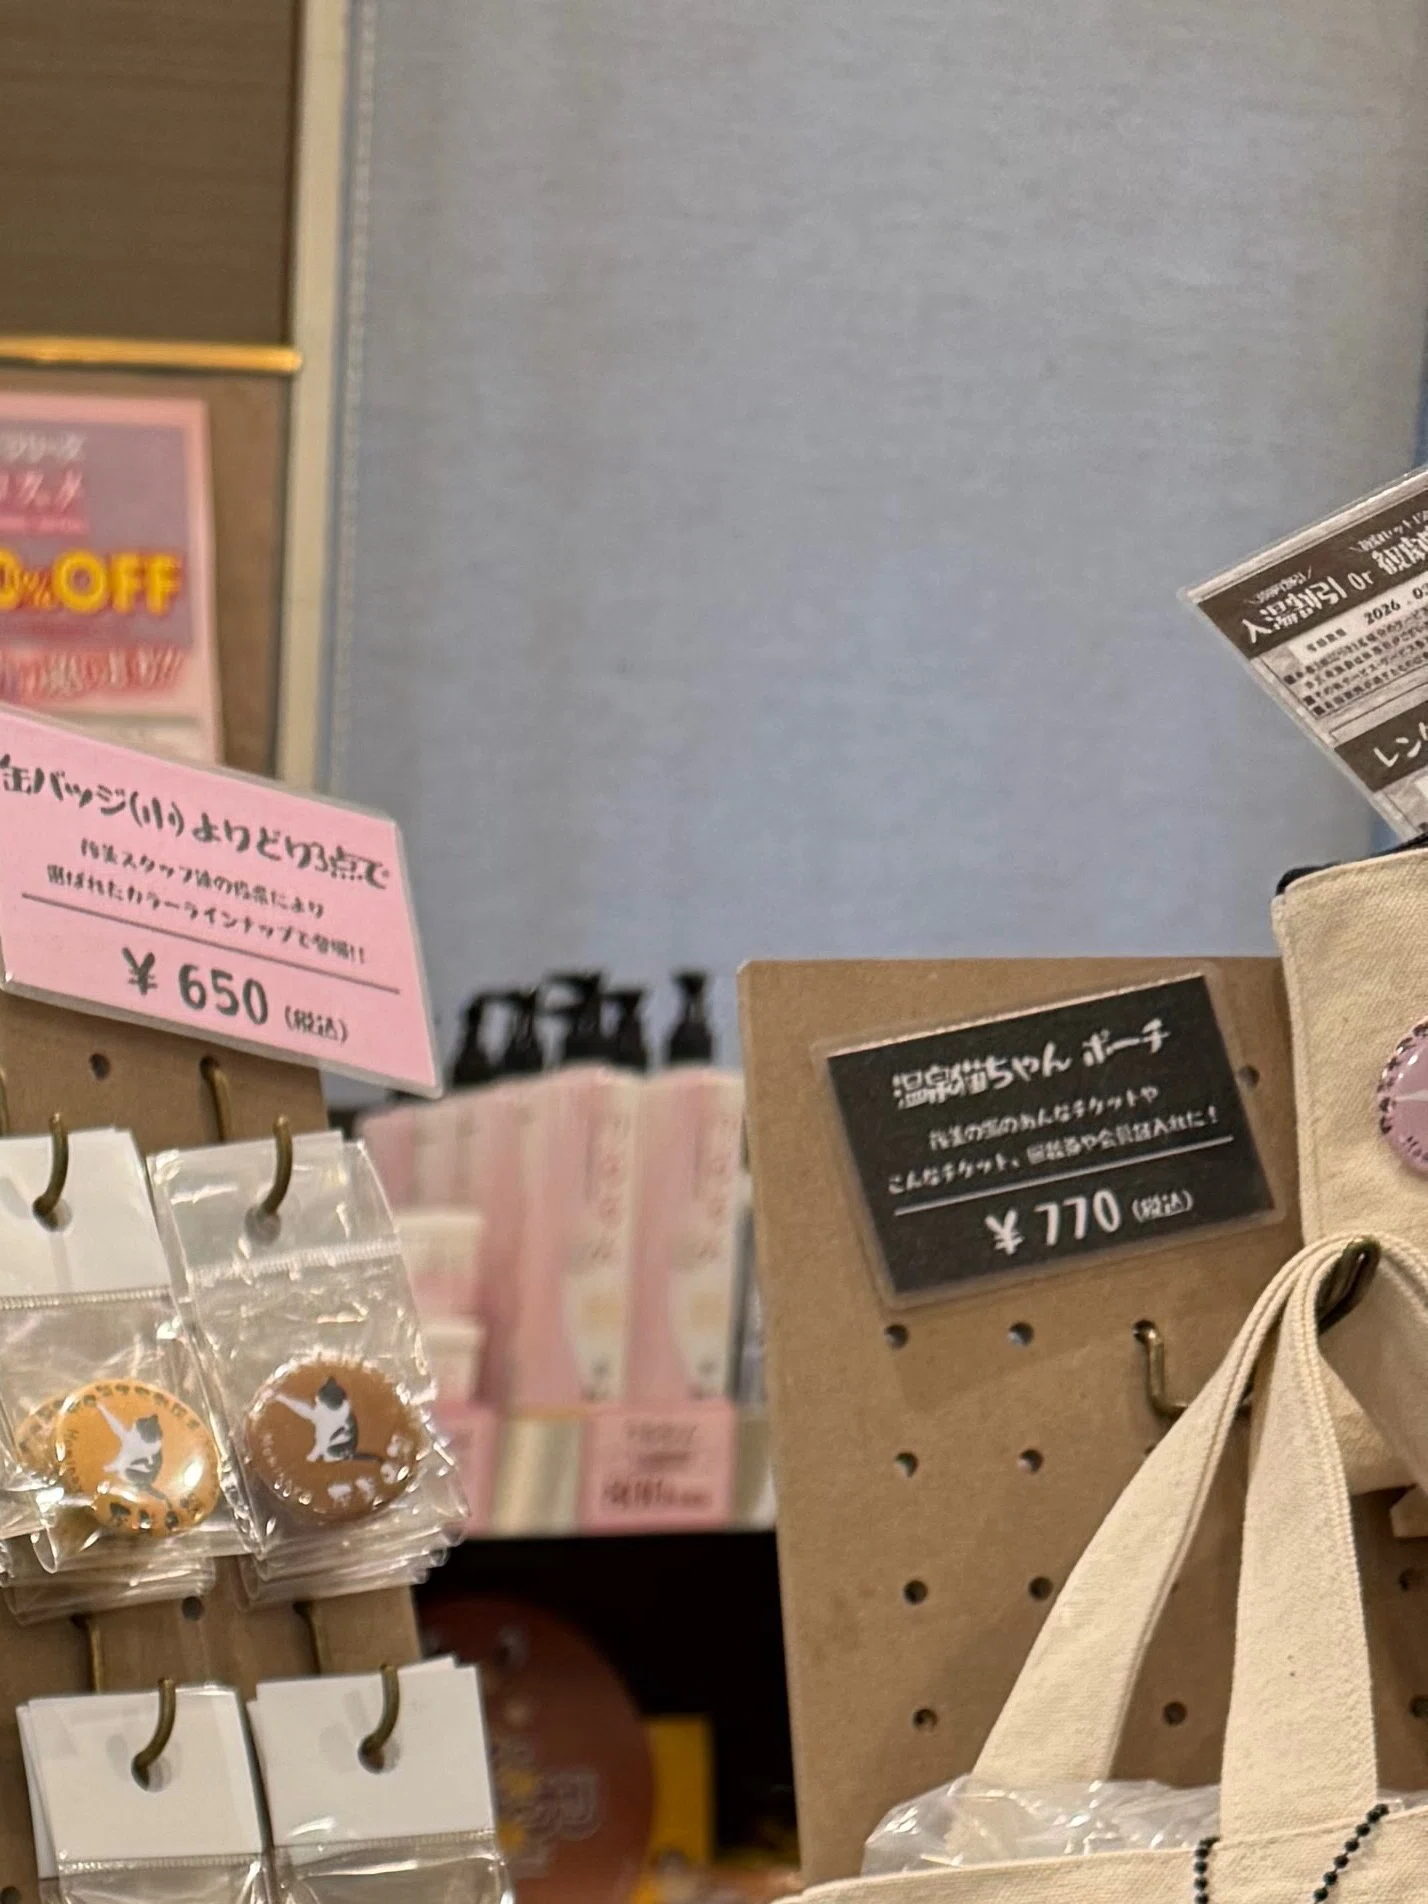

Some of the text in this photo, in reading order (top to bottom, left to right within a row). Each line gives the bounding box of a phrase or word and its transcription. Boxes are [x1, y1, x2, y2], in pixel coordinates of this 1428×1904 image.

[177, 962, 270, 1027] 650
[1081, 1018, 1172, 1068] ポーチ
[1036, 1188, 1123, 1249] 770
